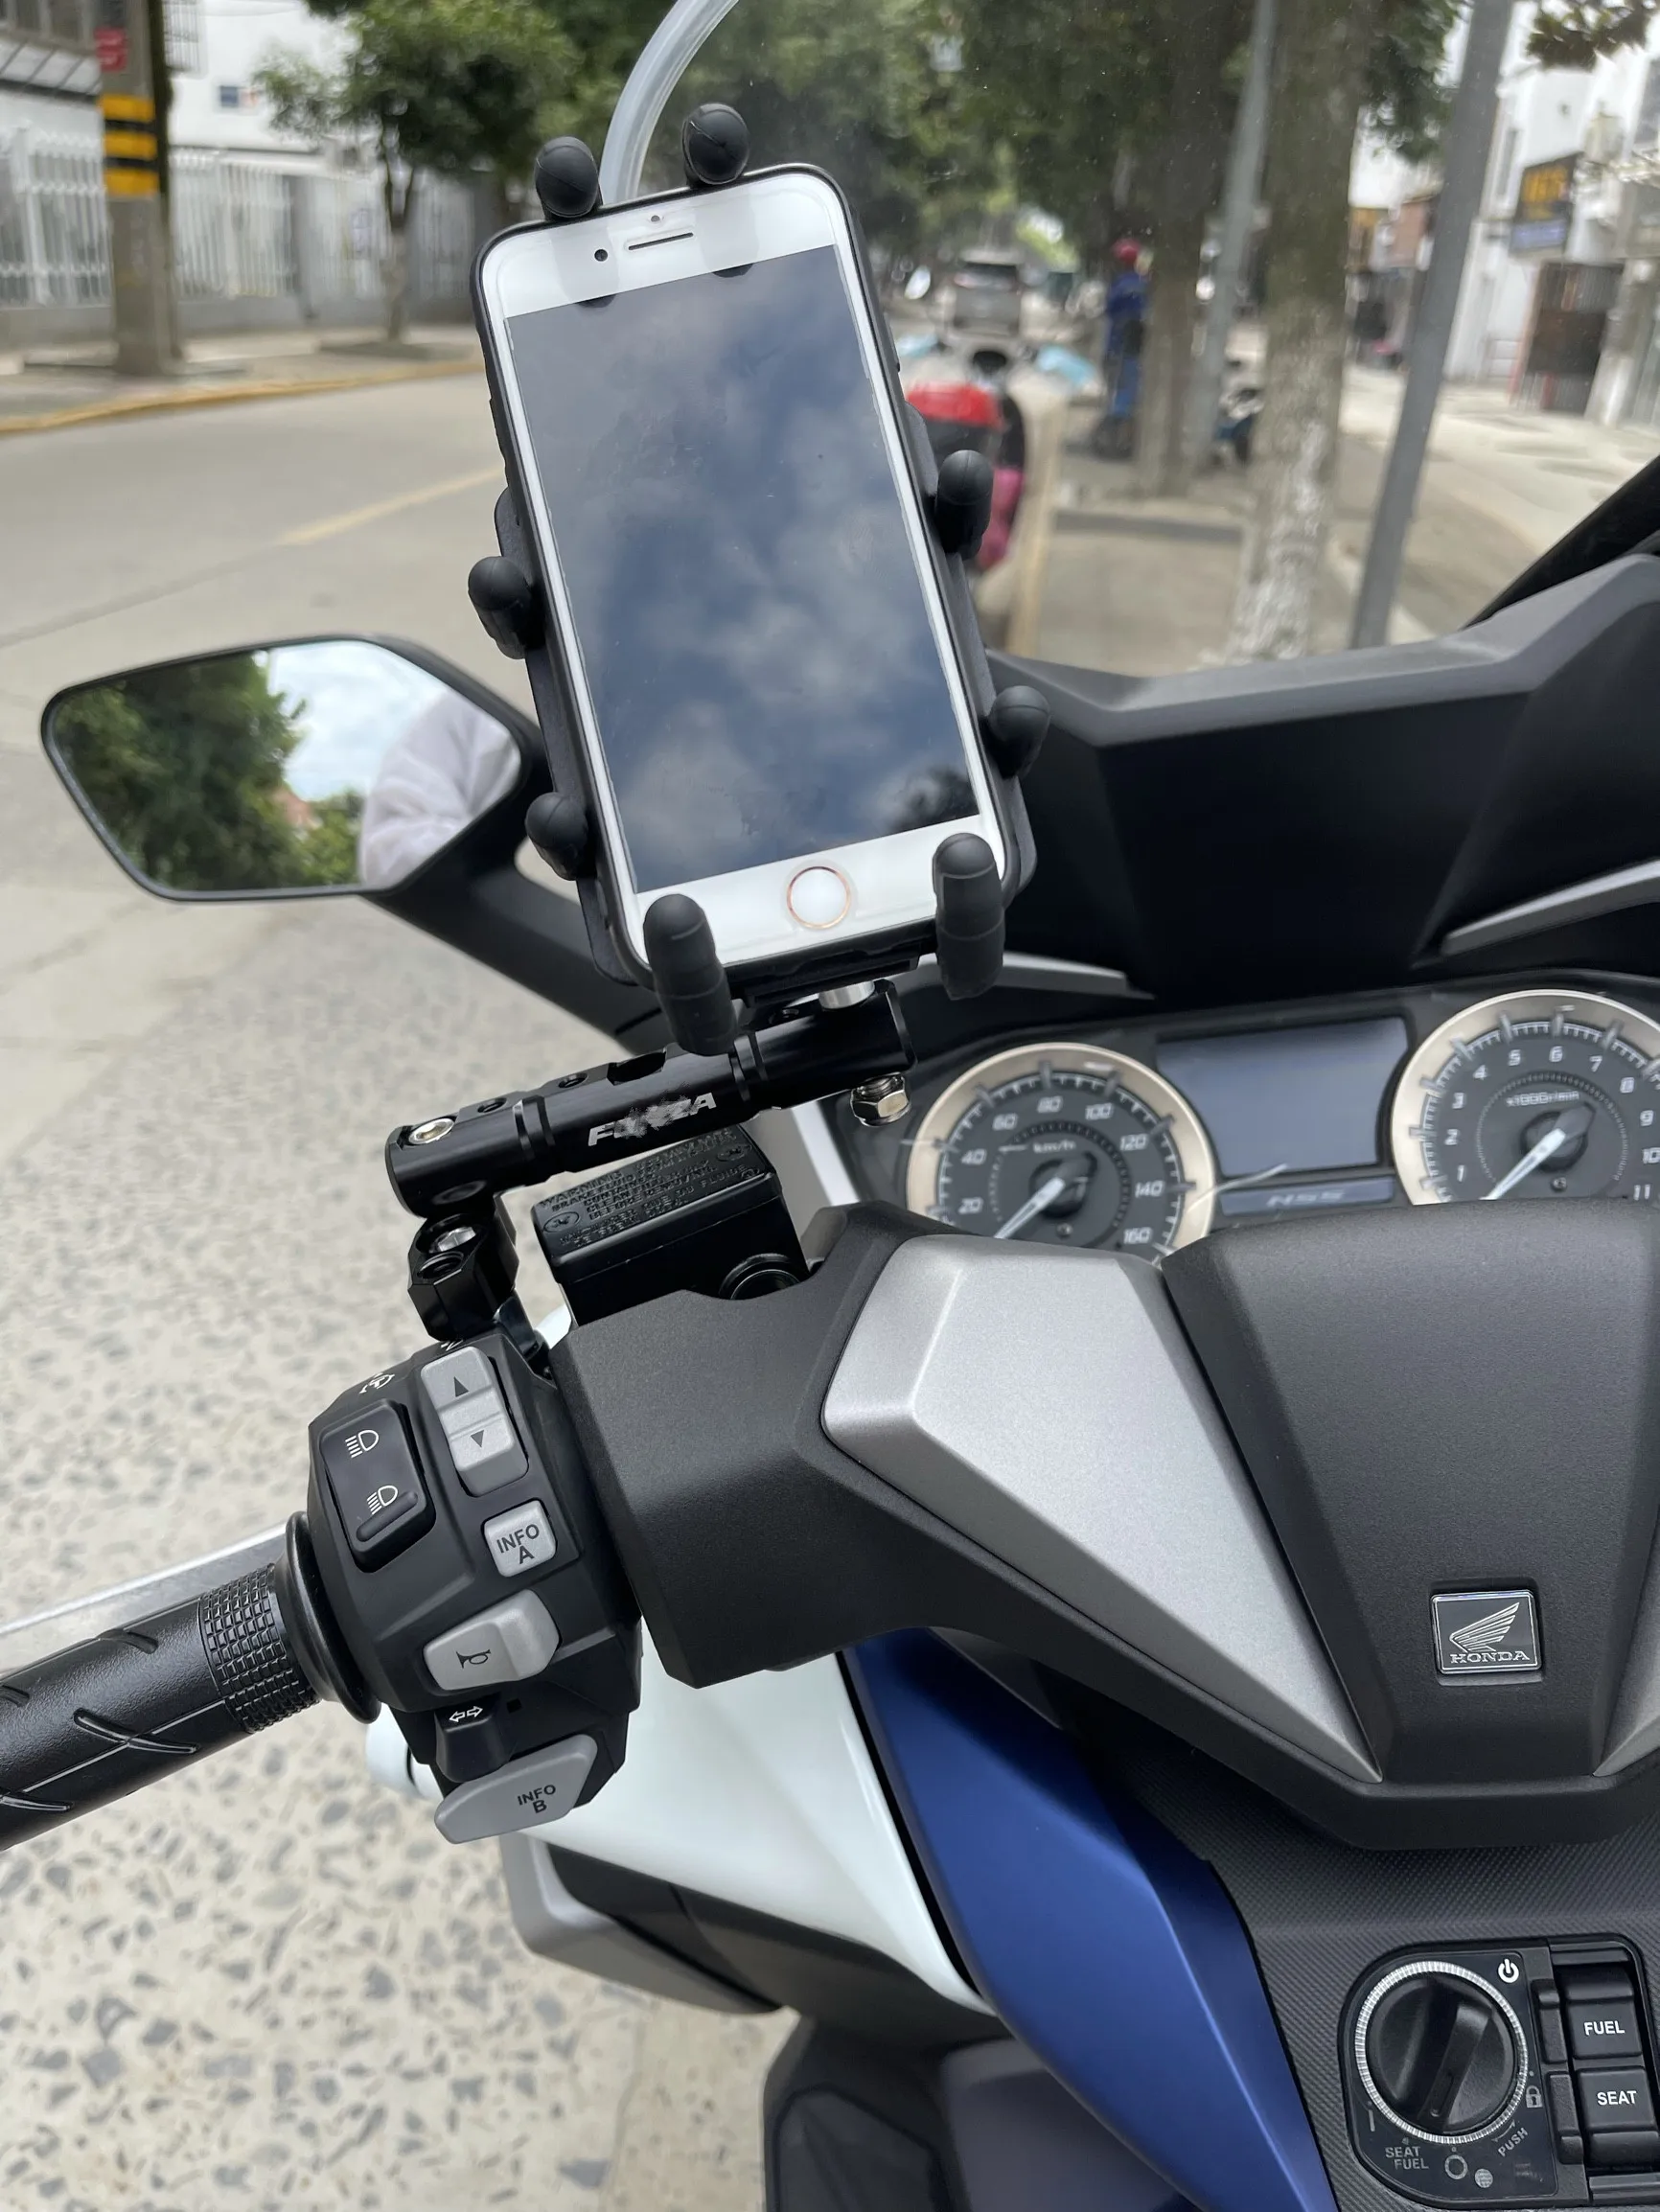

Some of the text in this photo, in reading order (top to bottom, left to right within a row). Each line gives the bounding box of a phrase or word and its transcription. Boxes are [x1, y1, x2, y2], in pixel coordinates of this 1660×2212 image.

[1508, 1049, 1521, 1066] 5
[1549, 1046, 1563, 1062] 6
[1589, 1055, 1602, 1072] 7
[1473, 1065, 1487, 1080] 4
[1037, 1095, 1064, 1114] 80
[1452, 1093, 1465, 1109] 3
[1084, 1102, 1114, 1120] 100
[1640, 1110, 1654, 1126] 9
[992, 1113, 1018, 1131] 60
[1119, 1134, 1148, 1151] 120
[1444, 1129, 1458, 1145] 2
[961, 1149, 986, 1165] 40
[1457, 1164, 1465, 1182] 1
[1135, 1180, 1164, 1198] 140
[1633, 1185, 1650, 1201] 11
[959, 1197, 983, 1213] 20
[1123, 1227, 1152, 1244] 160
[496, 1524, 540, 1554] INFO
[519, 1545, 535, 1564] A
[1449, 1650, 1531, 1664] HONDA
[518, 1785, 556, 1806] INFO
[533, 1799, 547, 1813] B
[1583, 2020, 1625, 2036] FUEL
[1597, 2090, 1637, 2106] SEAT
[1497, 2127, 1529, 2157] PUSH
[1385, 2146, 1421, 2158] SEAT
[1394, 2157, 1430, 2170] FUEL
